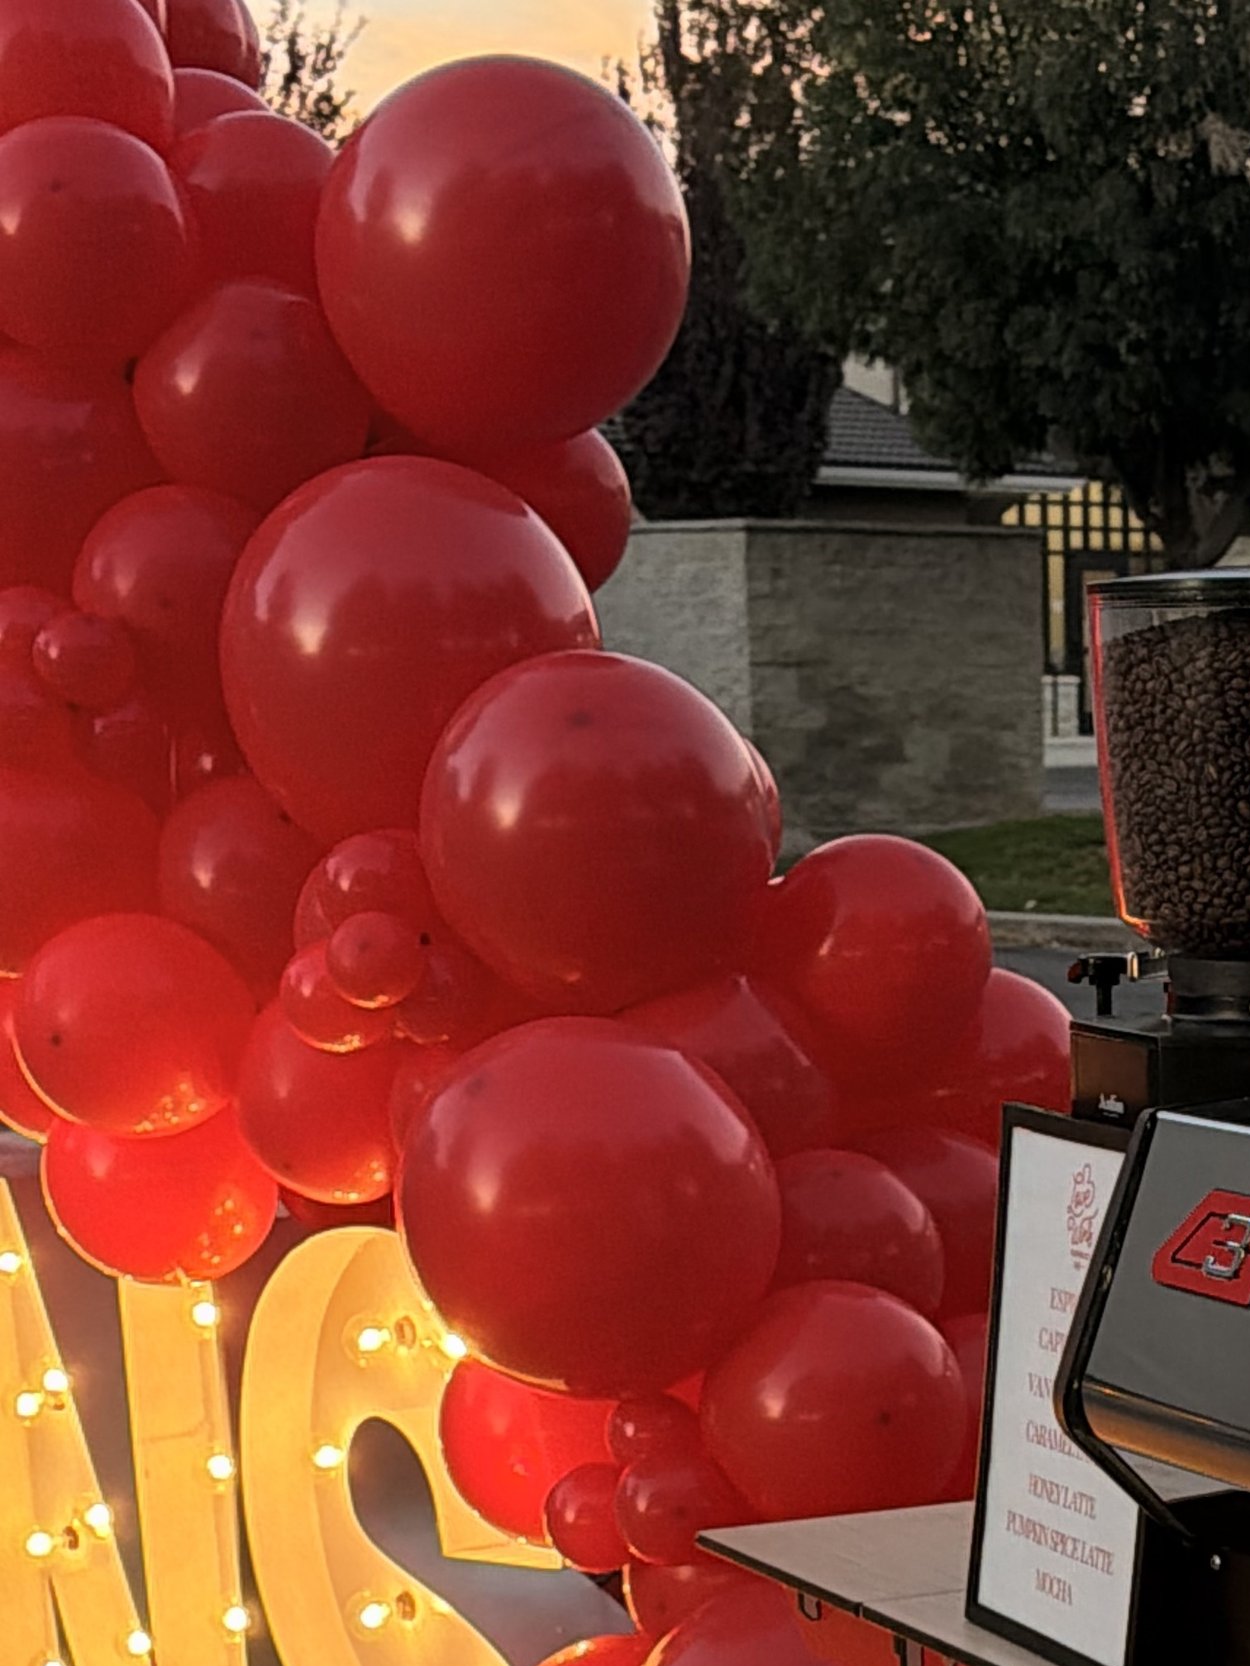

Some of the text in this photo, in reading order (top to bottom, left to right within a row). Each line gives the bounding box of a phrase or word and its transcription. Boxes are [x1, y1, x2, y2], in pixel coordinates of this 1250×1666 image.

[1027, 1472, 1097, 1520] HONEY LATTE
[1005, 1509, 1114, 1576] PUMPKIN SPICE LATTE
[1035, 1568, 1073, 1606] MOCHA
